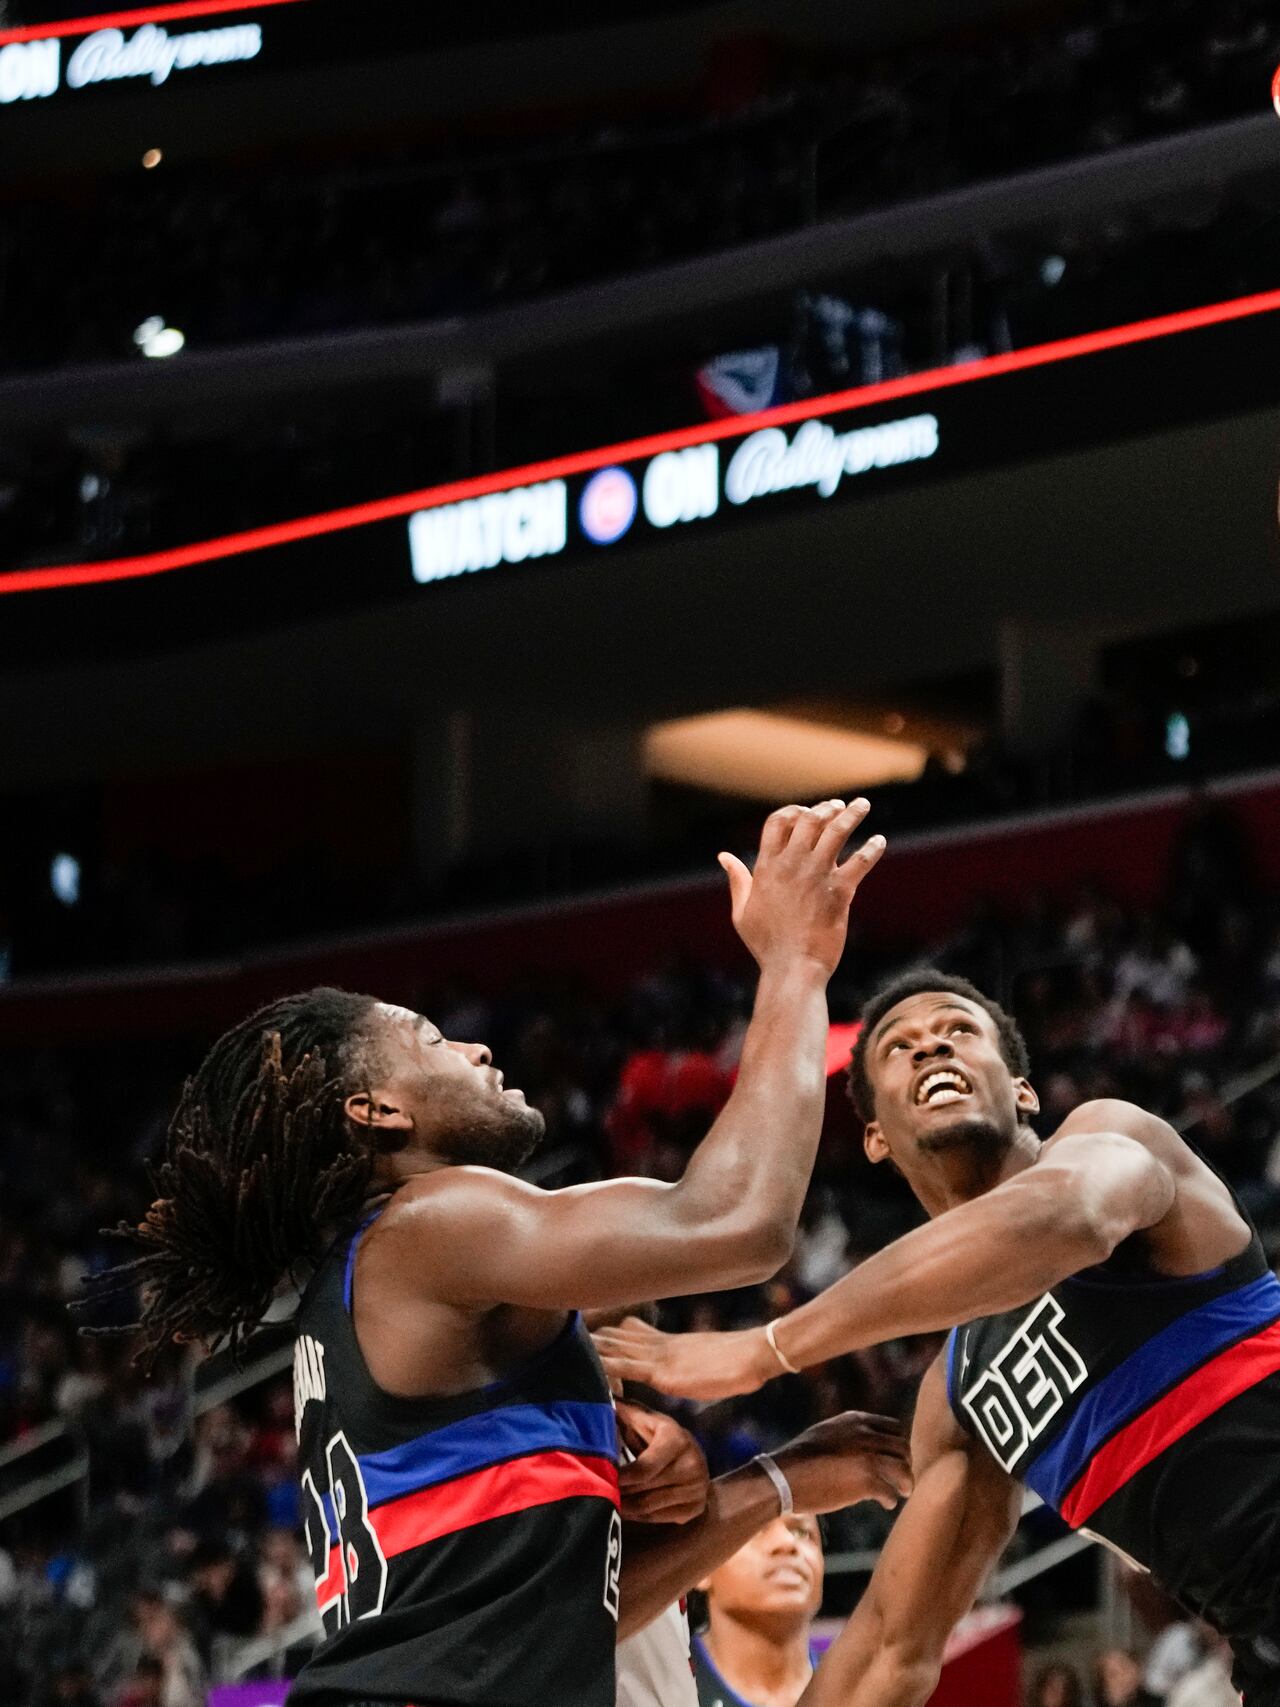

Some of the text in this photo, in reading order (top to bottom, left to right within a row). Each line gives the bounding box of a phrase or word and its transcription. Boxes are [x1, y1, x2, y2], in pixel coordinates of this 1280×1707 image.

[0, 37, 60, 103] ON
[408, 478, 567, 583] WATCH
[643, 443, 719, 528] ON
[962, 1291, 1088, 1474] DET
